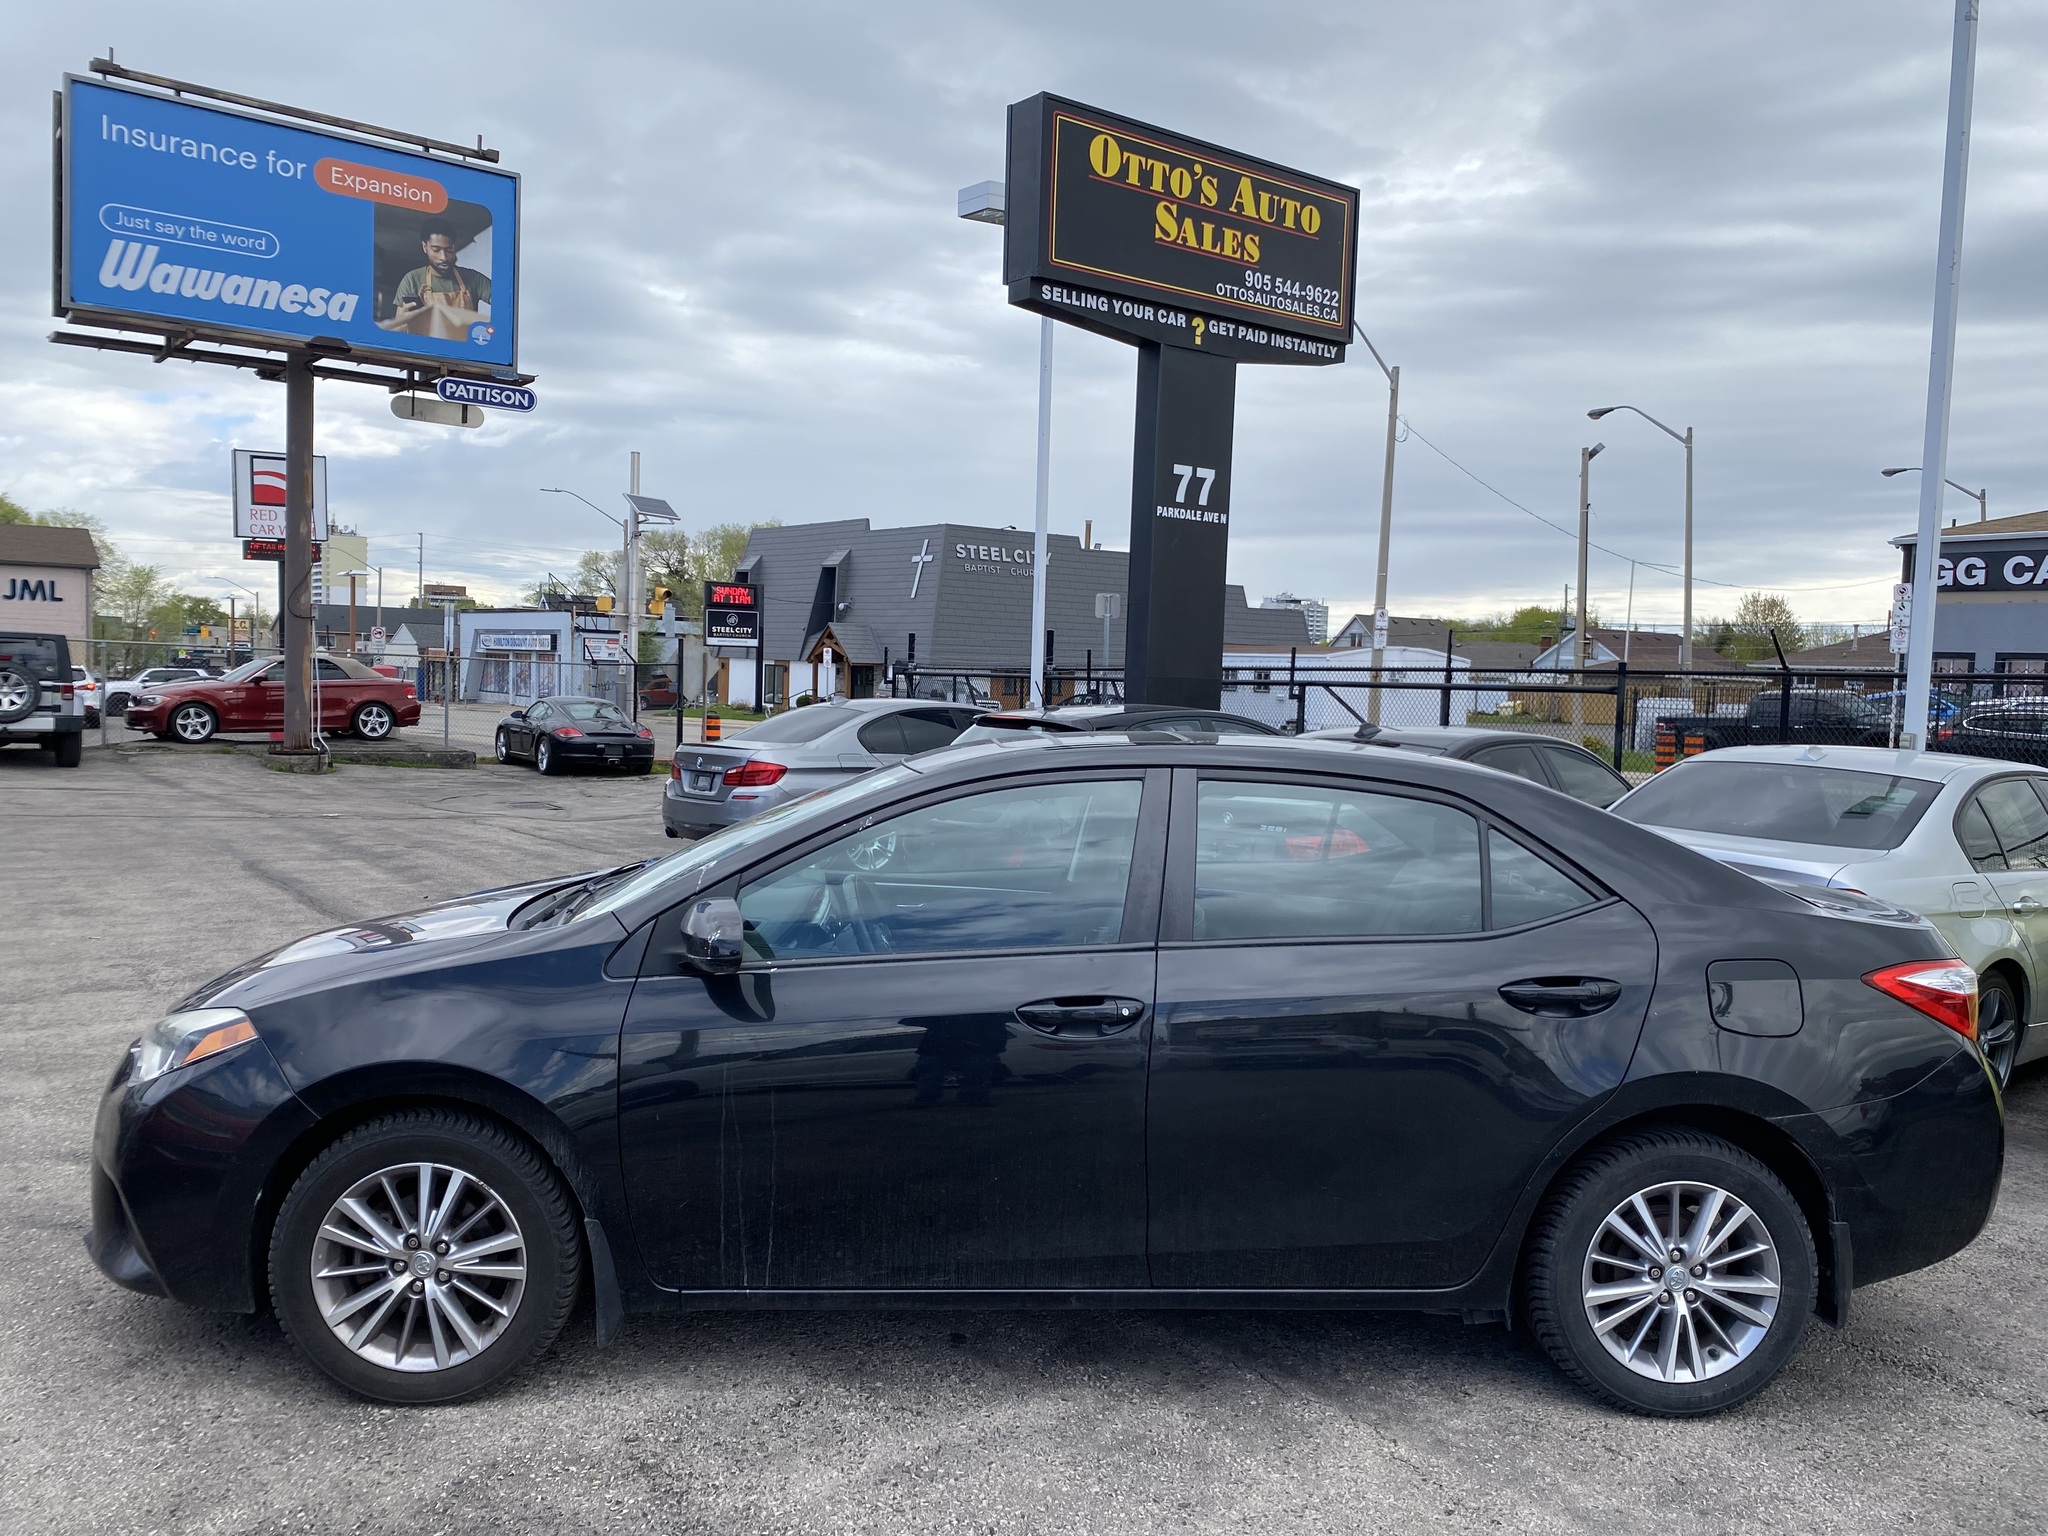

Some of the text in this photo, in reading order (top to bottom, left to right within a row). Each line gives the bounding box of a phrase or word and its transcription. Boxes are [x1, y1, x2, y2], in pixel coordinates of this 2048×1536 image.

[102, 114, 433, 204] Insurance for Expansion
[1229, 176, 1321, 234] AUTO
[115, 211, 266, 251] Just say the word
[1155, 200, 1260, 263] SALES
[98, 238, 359, 322] Wawanesa
[1245, 270, 1340, 308] 905 544-9622
[1216, 283, 1338, 321] OTTOSAUTOSALES.CA
[1041, 284, 1109, 312] SELLING
[1112, 299, 1154, 321] YOUR
[1157, 309, 1187, 328] CAR
[1208, 319, 1236, 337] GET
[1238, 325, 1268, 344] PAID
[1270, 333, 1338, 359] INSTANTLY
[445, 382, 529, 407] PATTISON
[1173, 463, 1216, 506] 77
[249, 508, 277, 522] RED
[249, 524, 275, 535] CAR
[1156, 505, 1227, 524] PARKDALE AVE N
[964, 563, 1034, 577] BAPTIST CHUR
[2, 578, 63, 602] JML
[713, 594, 751, 604] AT 11AM
[716, 586, 749, 596] SUNDAY
